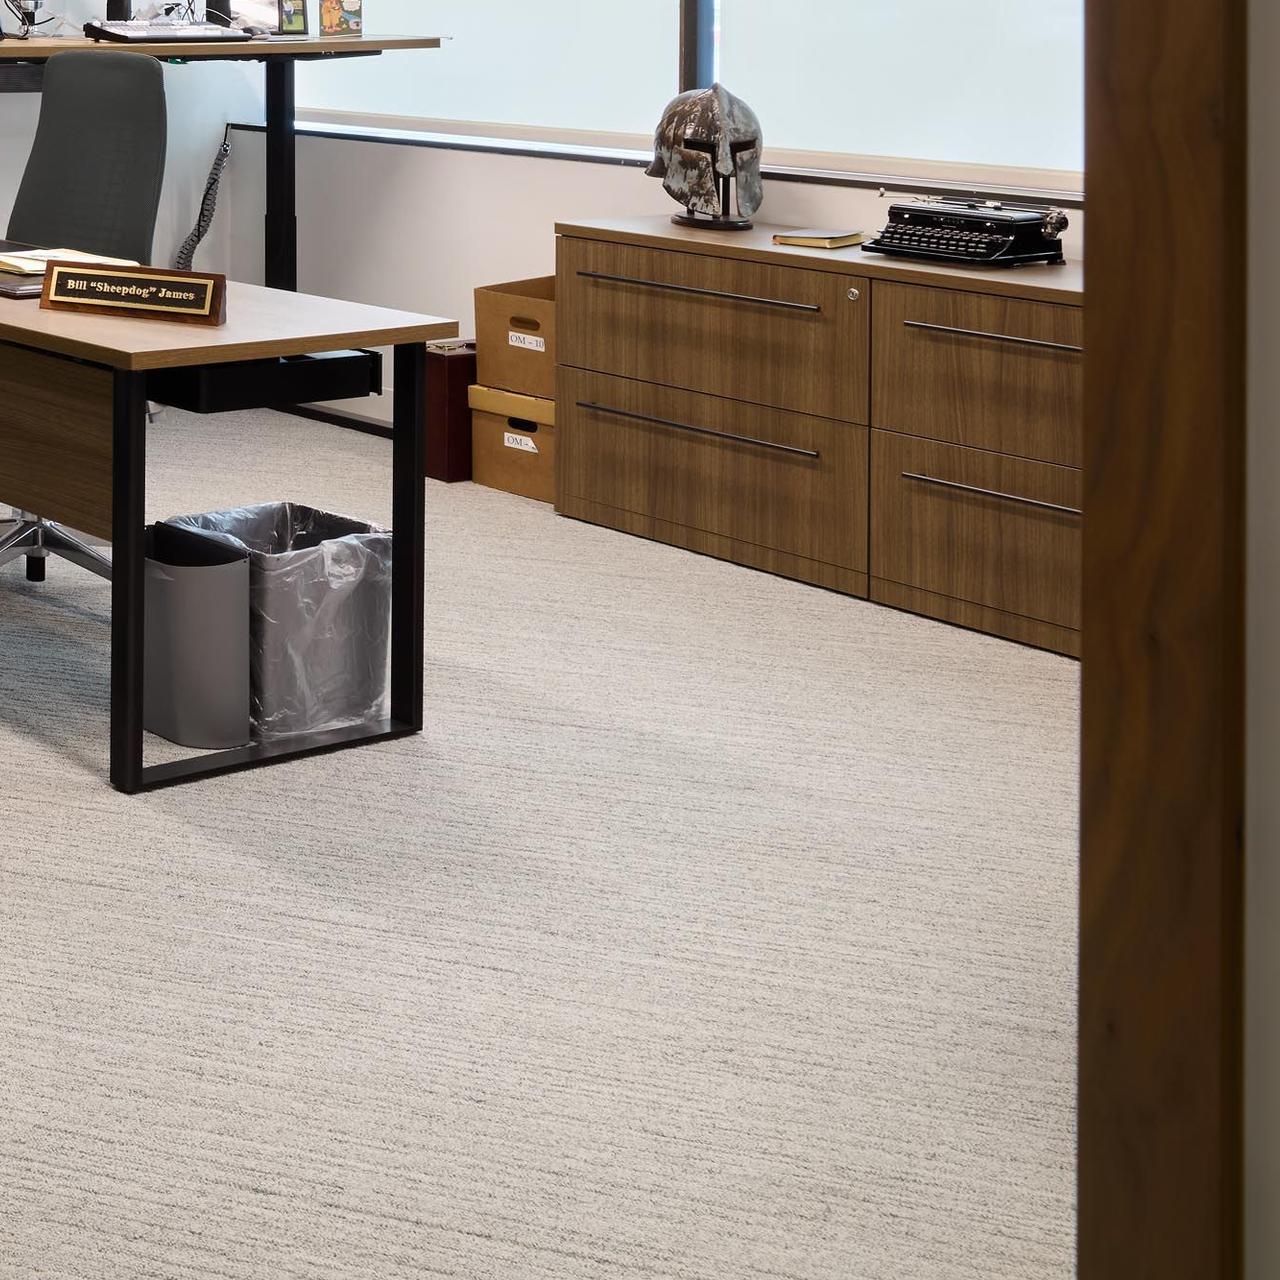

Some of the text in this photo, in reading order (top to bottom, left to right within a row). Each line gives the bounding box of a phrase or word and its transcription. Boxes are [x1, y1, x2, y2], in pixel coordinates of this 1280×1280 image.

[67, 278, 195, 301] Bill “Sheepdog” James
[510, 334, 526, 345] OM
[506, 435, 523, 447] OM
